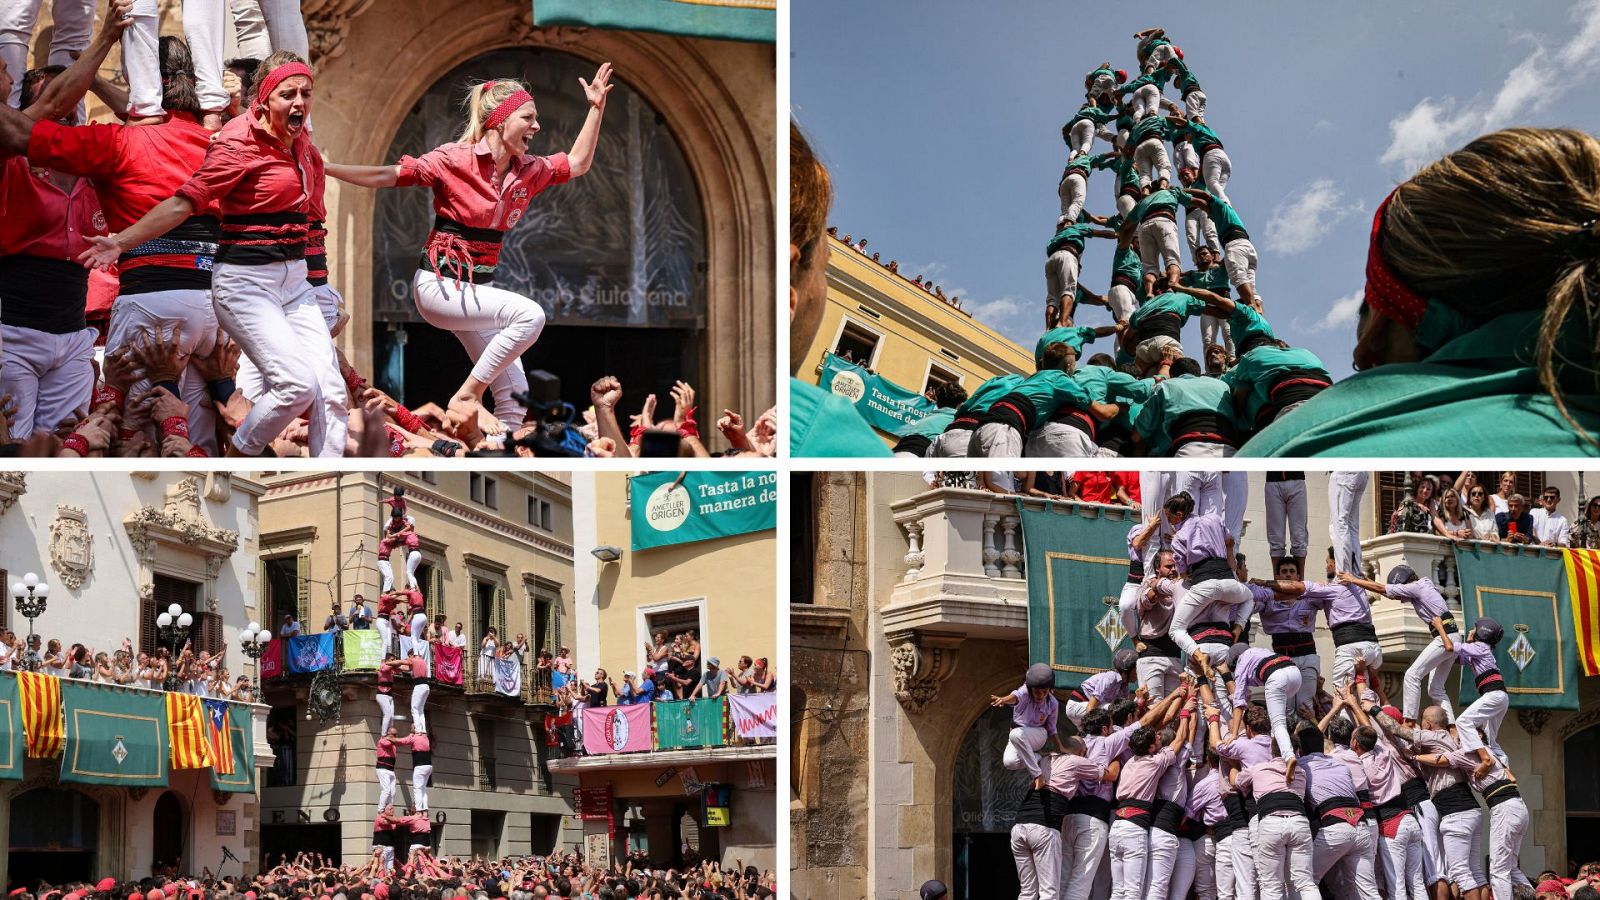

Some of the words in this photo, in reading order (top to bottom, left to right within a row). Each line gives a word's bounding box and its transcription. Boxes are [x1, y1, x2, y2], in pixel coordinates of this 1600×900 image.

[834, 384, 859, 399] ORIGEN
[872, 387, 895, 407] Tasta
[897, 399, 906, 411] la
[868, 398, 903, 421] manera
[698, 482, 739, 498] Tasta
[742, 476, 755, 490] la
[758, 472, 777, 486] no
[651, 500, 684, 513] AMETLLER
[699, 496, 756, 515] manera
[759, 488, 777, 504] de
[651, 507, 685, 521] ORIGEN
